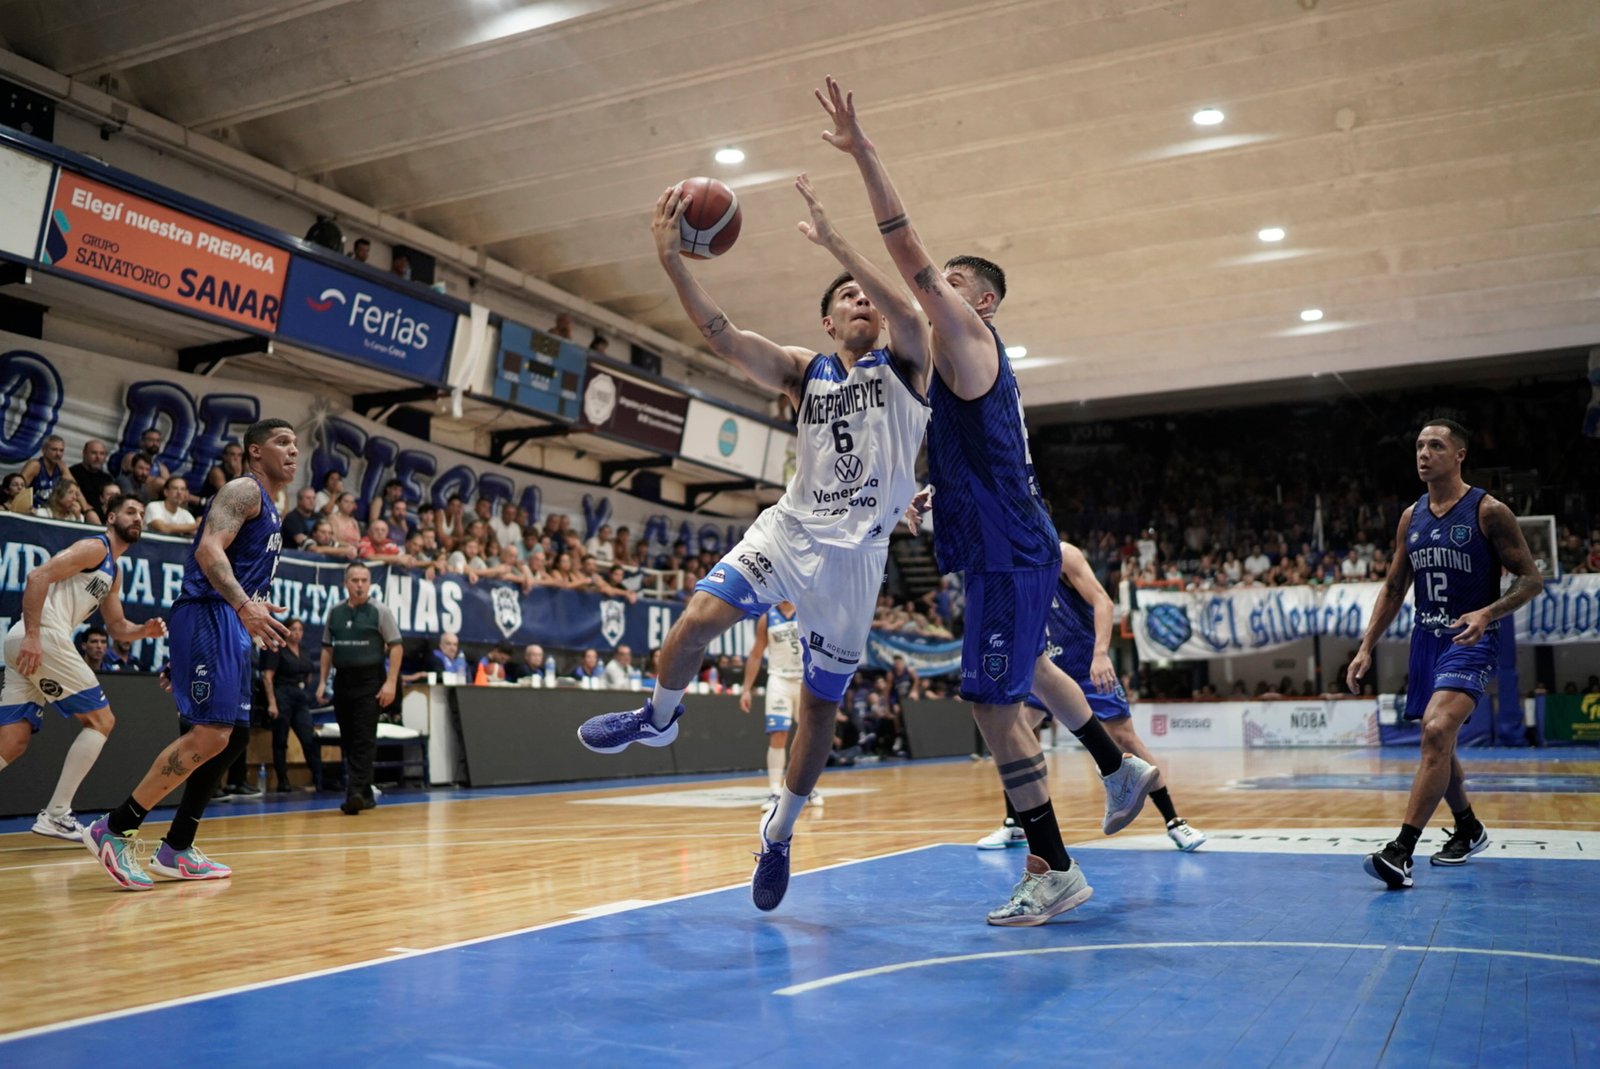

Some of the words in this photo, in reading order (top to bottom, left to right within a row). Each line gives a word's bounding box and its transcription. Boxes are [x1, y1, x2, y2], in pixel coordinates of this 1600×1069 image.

[71, 187, 125, 221] Elegí
[125, 210, 194, 246] nuestra
[196, 232, 276, 275] PREPAGA
[81, 233, 120, 254] GRUPO
[75, 247, 171, 290] SANATORIO
[177, 267, 279, 324] SANAR
[349, 292, 431, 350] Ferias
[832, 420, 854, 454] 6
[1425, 572, 1448, 602] 12
[1200, 597, 1242, 650] El
